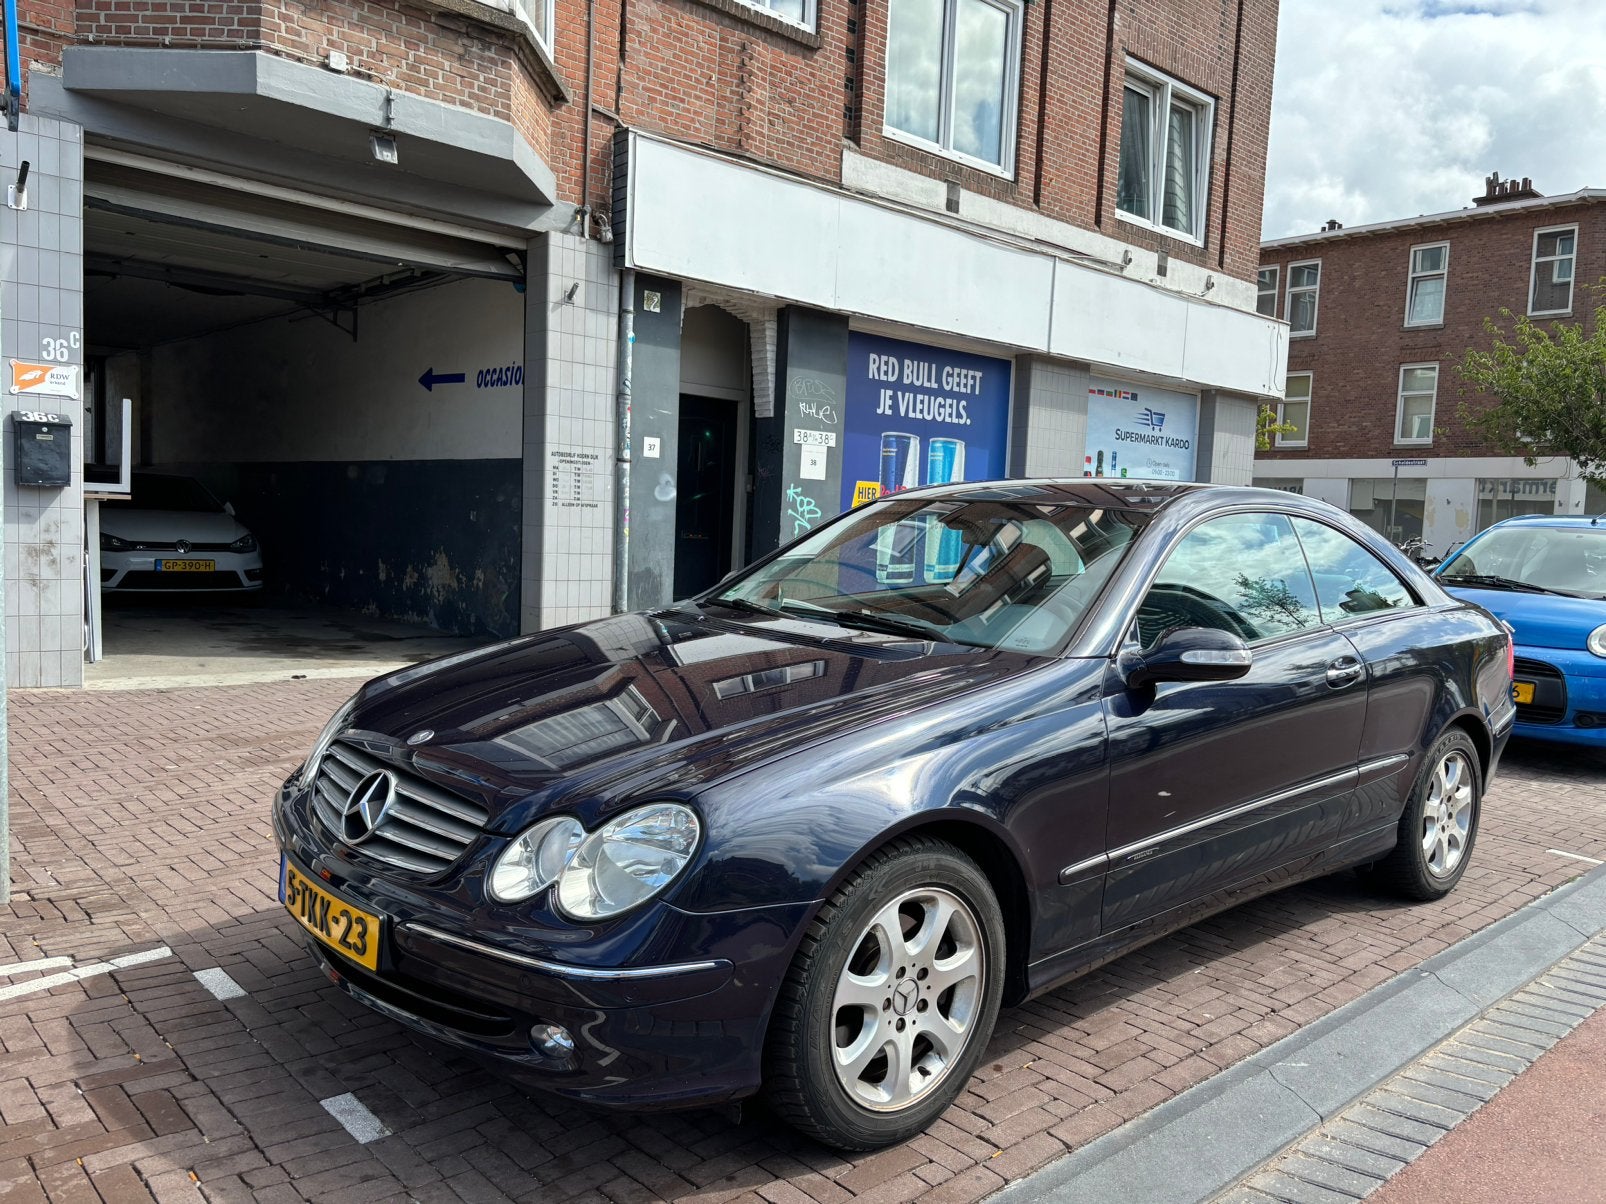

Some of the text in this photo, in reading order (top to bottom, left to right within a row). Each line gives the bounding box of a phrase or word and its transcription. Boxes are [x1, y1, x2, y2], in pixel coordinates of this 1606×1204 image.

[50, 372, 70, 381] RDW
[476, 361, 524, 389] OCCASIO
[868, 353, 983, 395] RED BULL GEEFT
[876, 388, 971, 425] JE VLEUGELS.
[648, 443, 656, 451] 37
[1165, 436, 1189, 450] KARDO
[810, 459, 817, 467] 38
[858, 487, 877, 500] HIER
[164, 561, 211, 570] GP-390-H
[287, 869, 368, 956] 5-TKK-23
